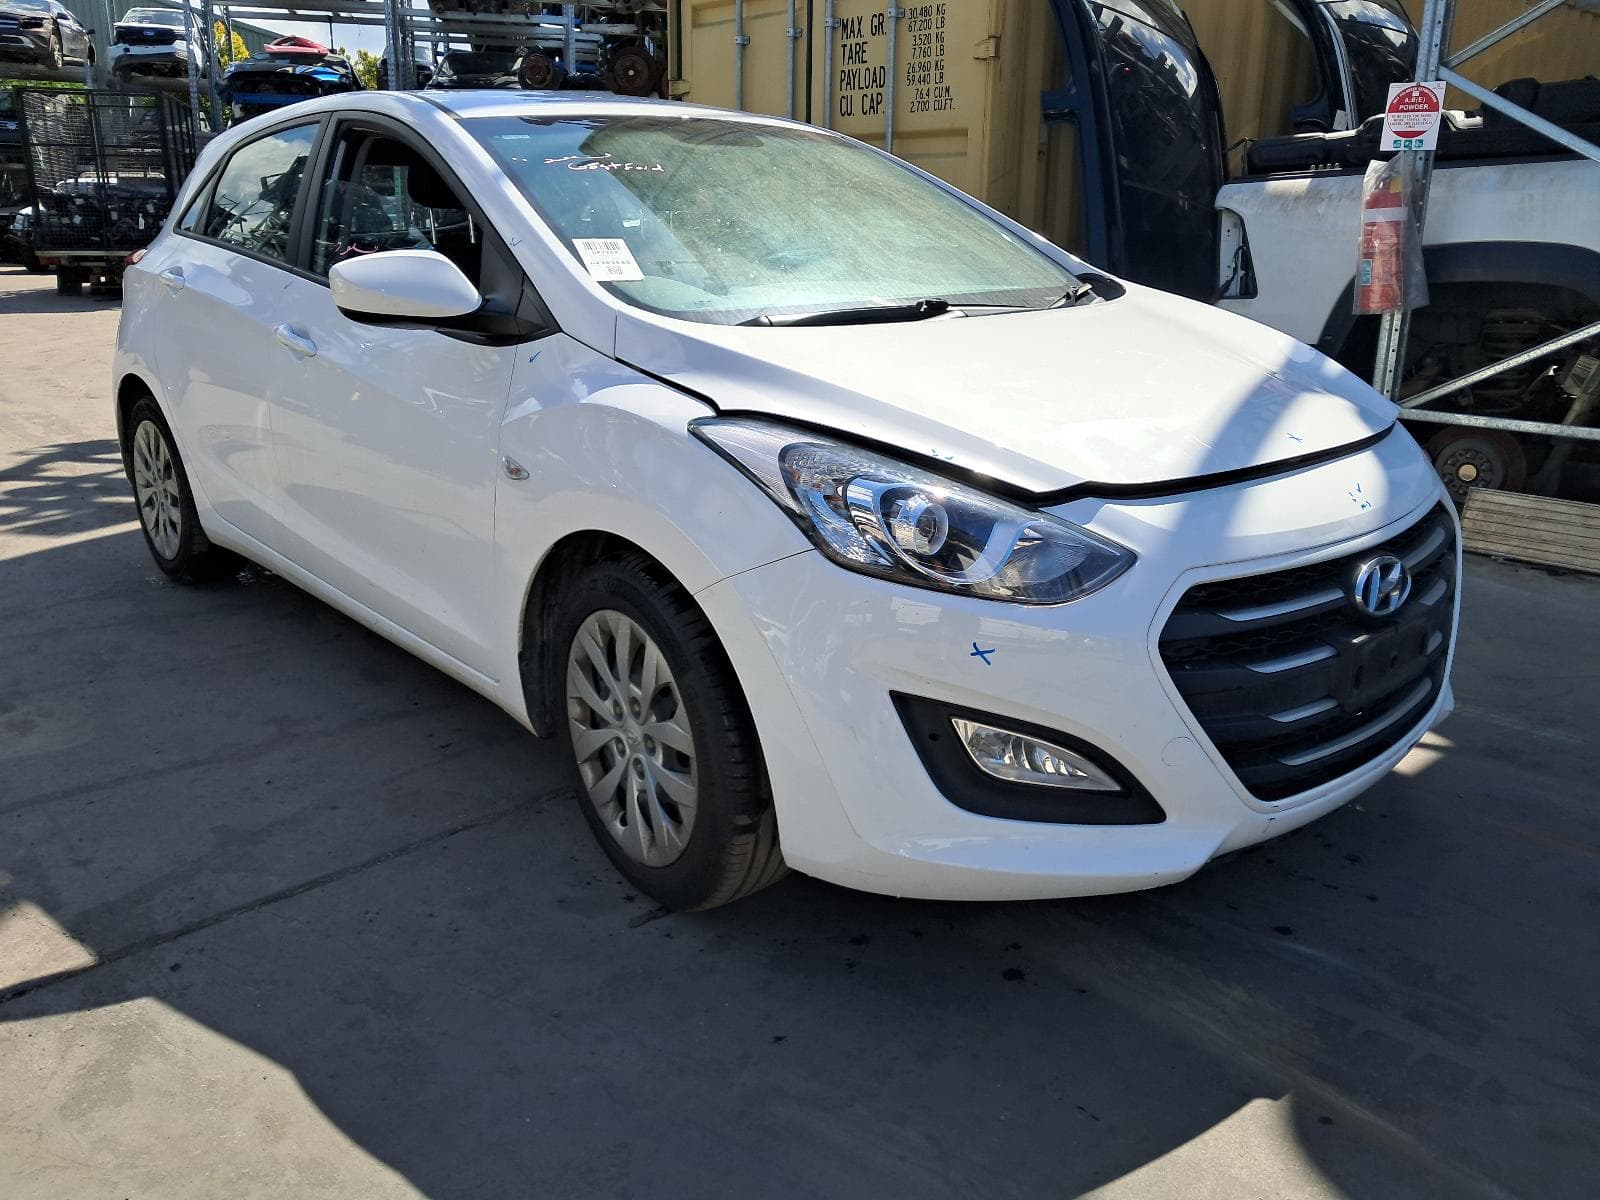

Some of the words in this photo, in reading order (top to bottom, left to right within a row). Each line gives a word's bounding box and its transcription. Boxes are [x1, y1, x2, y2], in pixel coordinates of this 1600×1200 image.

[908, 5, 933, 20] 30.480
[936, 3, 946, 16] KG
[841, 16, 865, 40] MAX.
[871, 13, 887, 36] GR.
[908, 18, 932, 32] 67.200
[935, 16, 945, 29] LB
[912, 33, 932, 46] 3.520
[935, 31, 945, 44] KG
[841, 41, 868, 65] TARE
[912, 46, 932, 60] 7.760
[935, 44, 945, 57] LB
[907, 61, 931, 74] 26.960
[934, 59, 945, 71] KG
[840, 66, 886, 91] PAYLOAD
[906, 73, 931, 87] 59.440
[934, 72, 944, 84] LB
[915, 87, 930, 100] 76.4
[840, 95, 855, 117] CU.
[861, 92, 885, 115] CAP.
